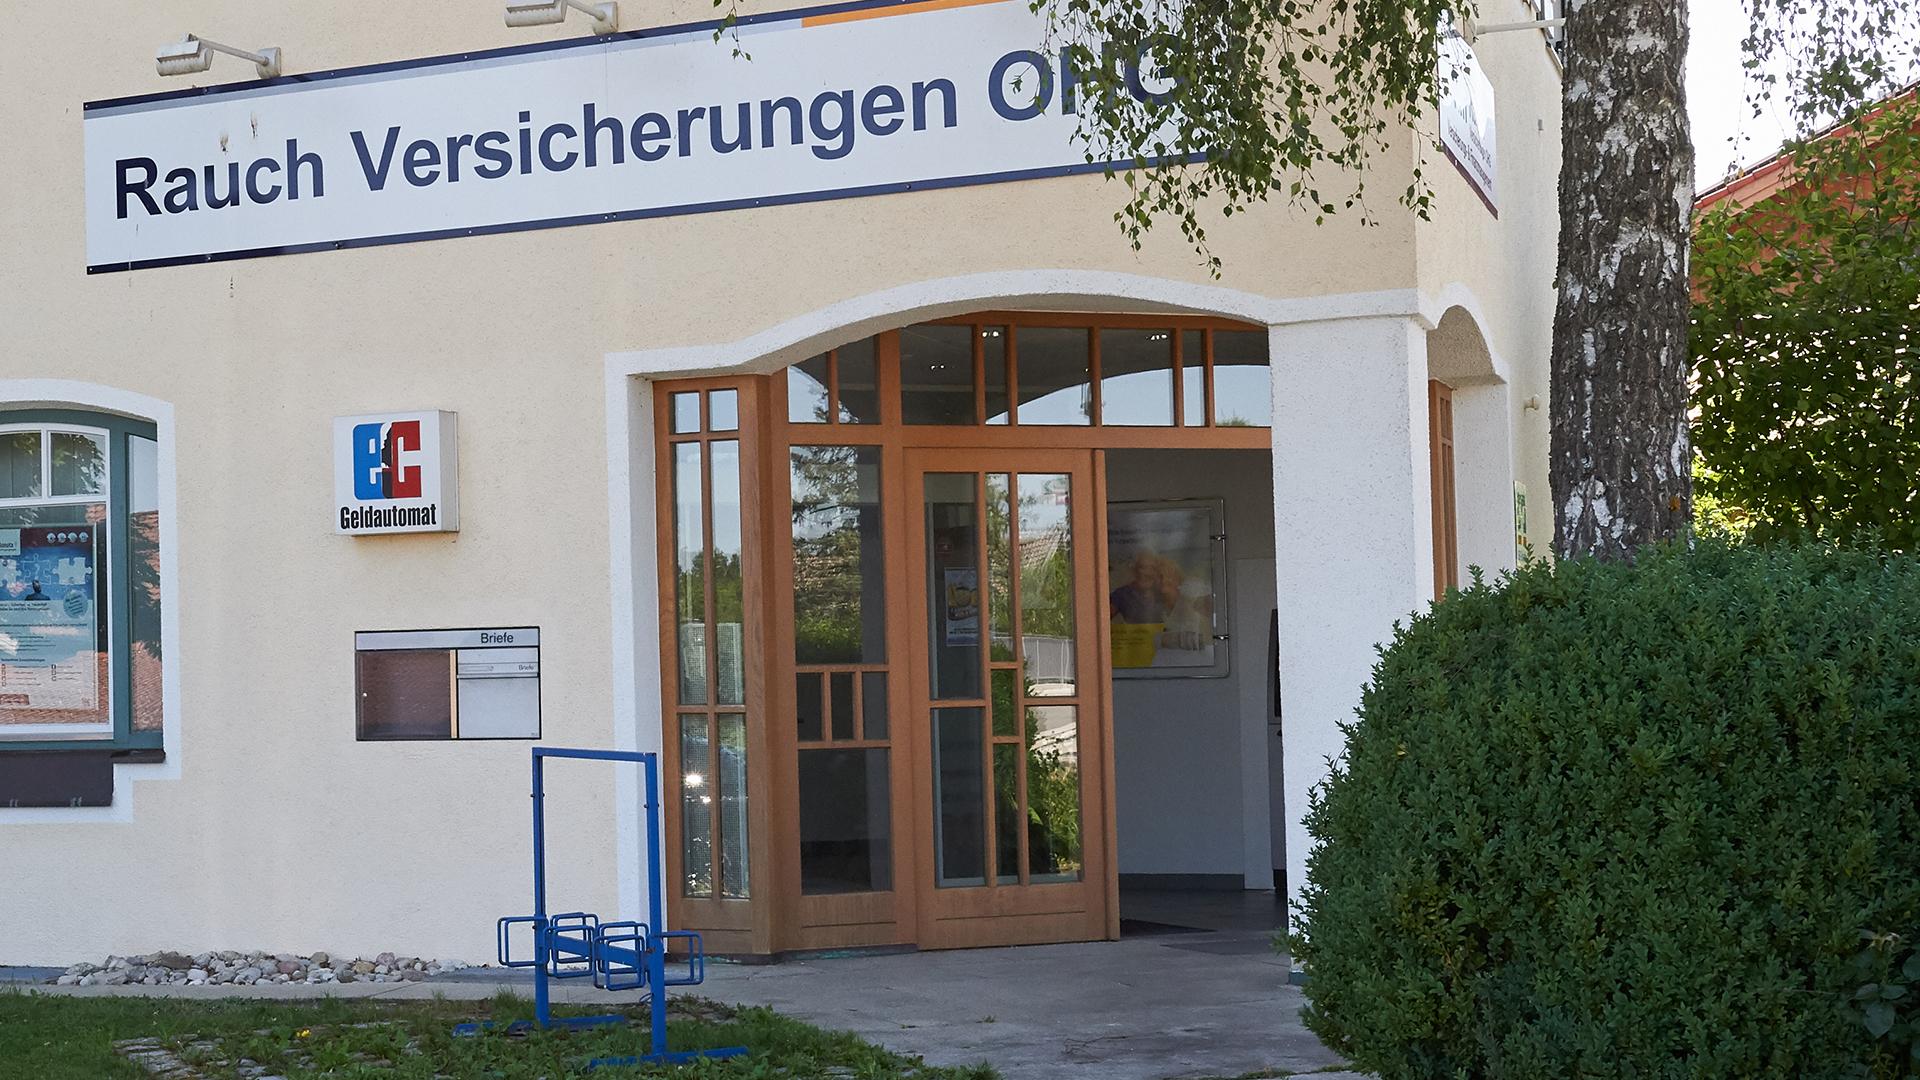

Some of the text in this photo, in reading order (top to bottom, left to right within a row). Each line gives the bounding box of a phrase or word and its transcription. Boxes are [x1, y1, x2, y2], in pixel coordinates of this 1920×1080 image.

[115, 138, 325, 219] Rauch
[350, 77, 958, 191] Versicherungen
[340, 503, 436, 529] Geldautomat
[480, 632, 514, 643] Briefe
